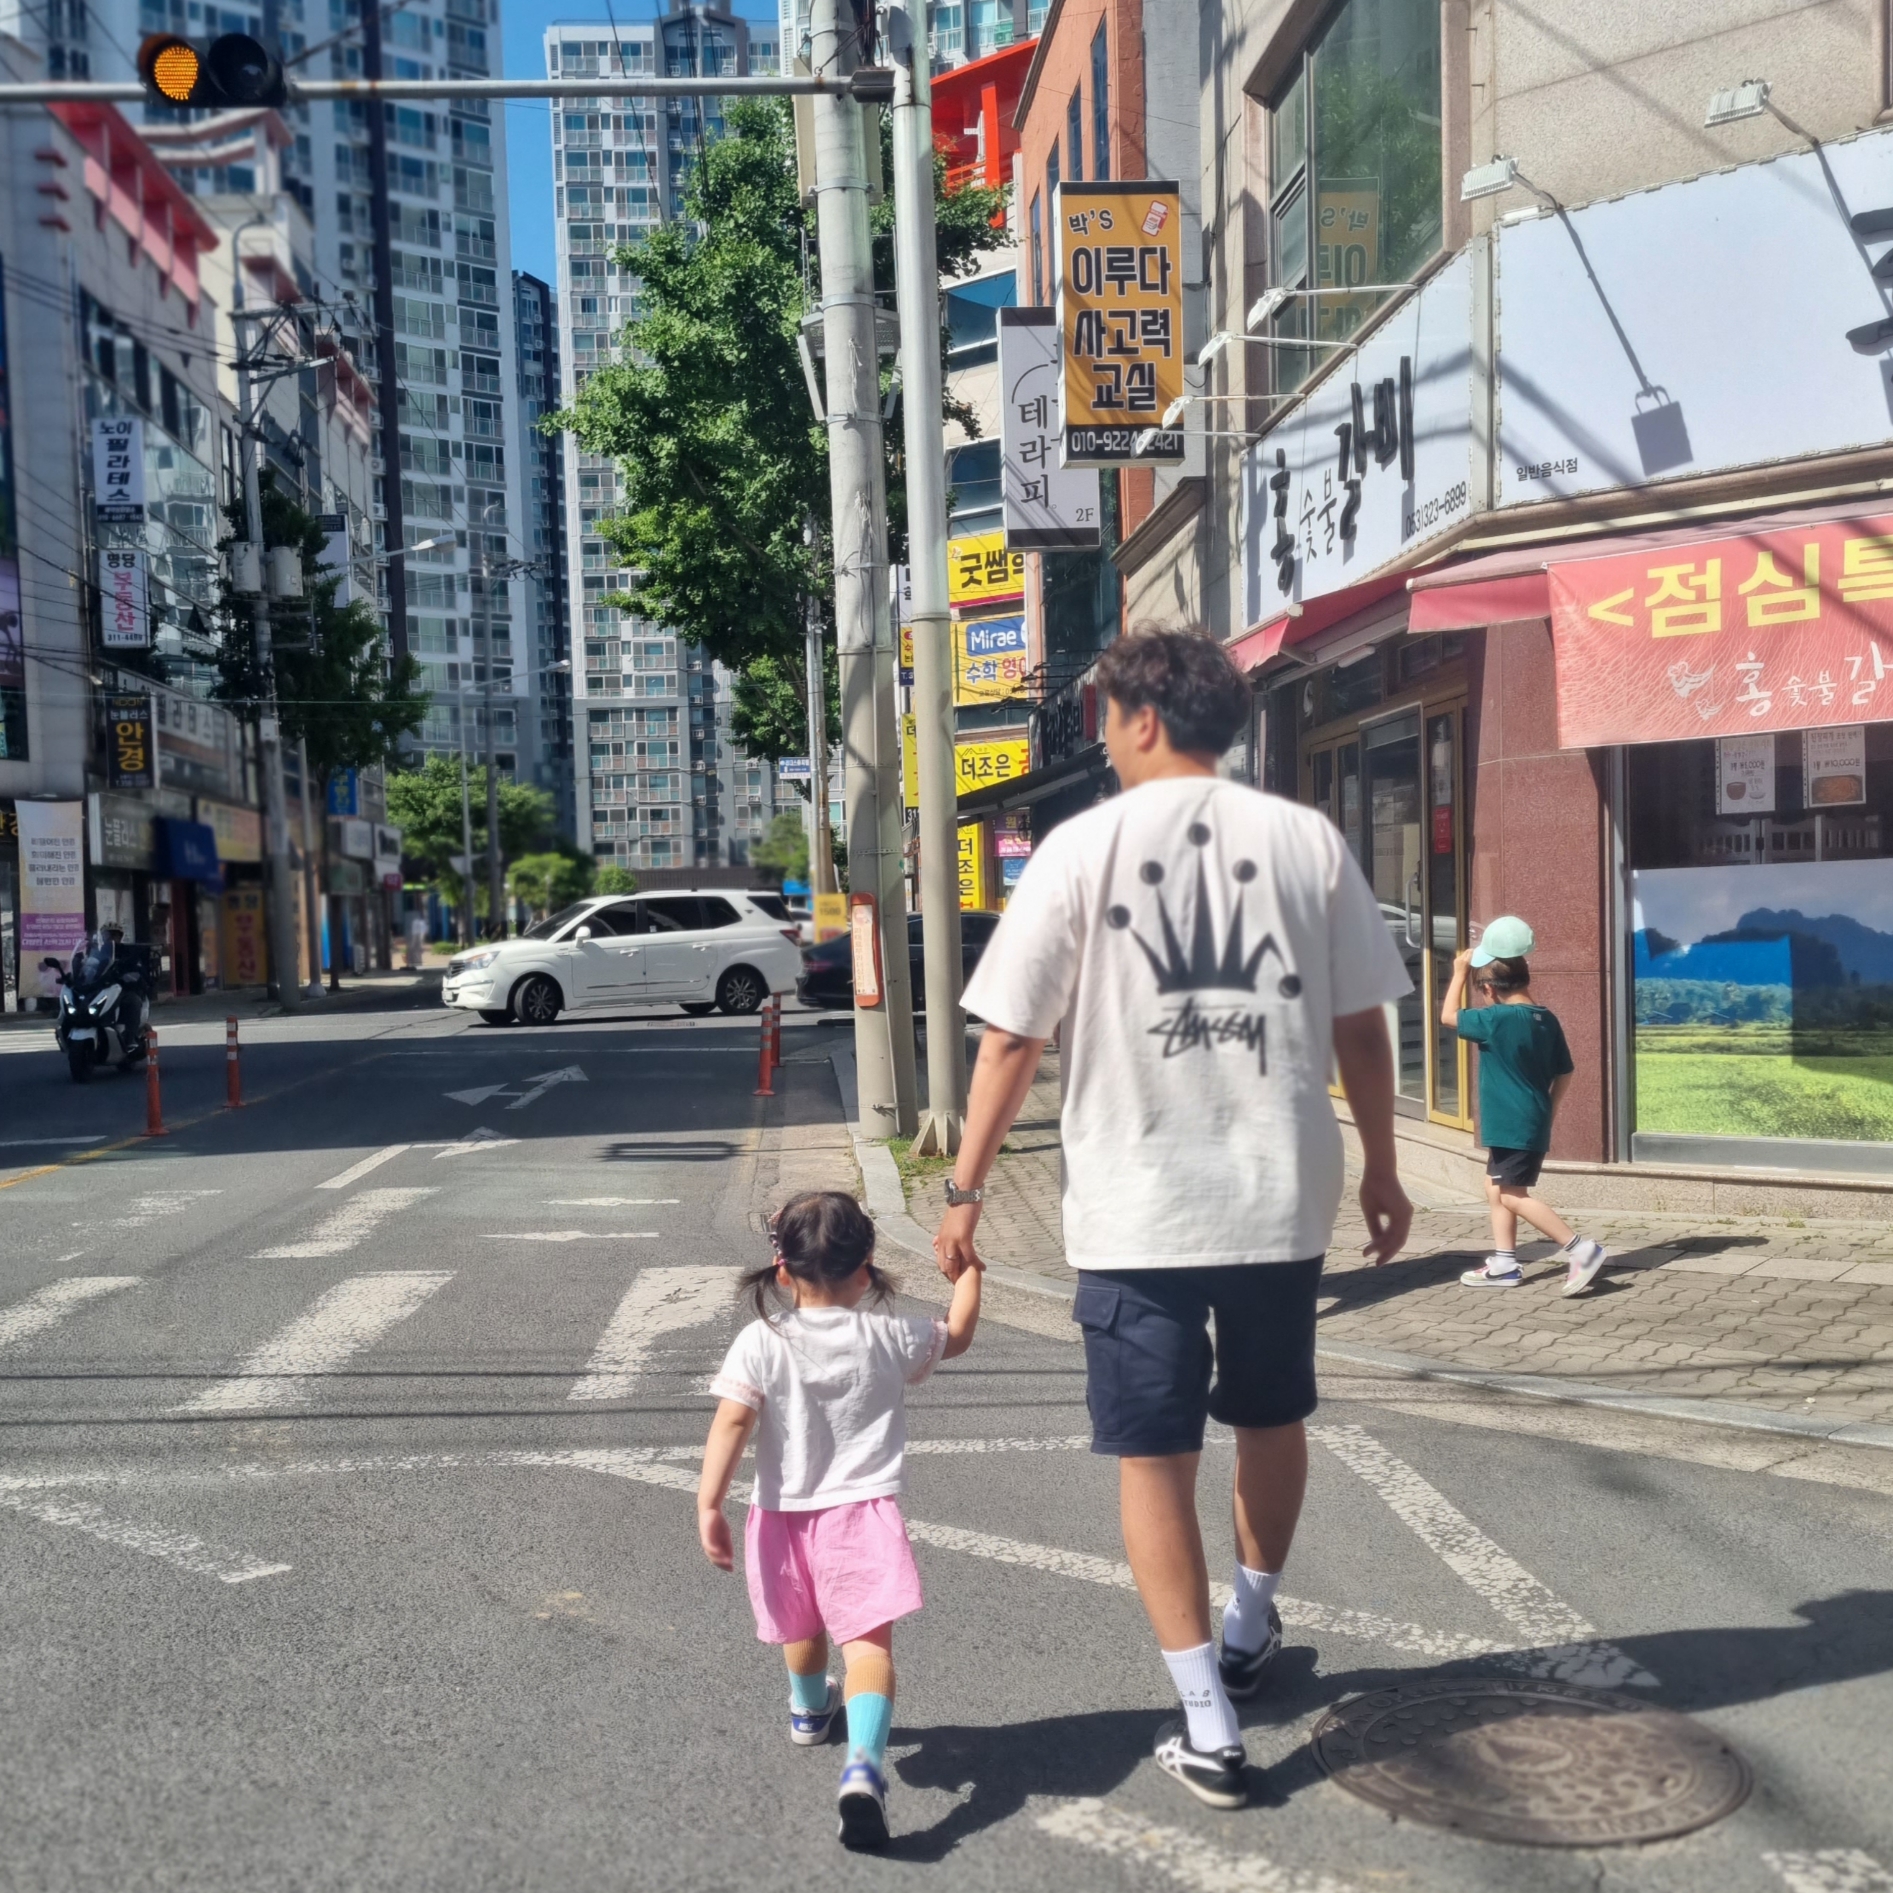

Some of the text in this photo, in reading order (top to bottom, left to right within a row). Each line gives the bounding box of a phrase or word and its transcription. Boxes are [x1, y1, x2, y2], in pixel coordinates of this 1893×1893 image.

[1070, 245, 1172, 297] 이루다
[1073, 307, 1172, 359] 사고력
[1091, 362, 1157, 413] 교실
[99, 421, 133, 435] 노이
[107, 438, 131, 502] 필라테스
[1516, 457, 1579, 482] 일반음식점
[1075, 507, 1095, 523] 2F
[1405, 480, 1468, 538] 053)323-6899
[106, 552, 136, 569] 명당
[113, 571, 136, 631] 부동산
[971, 630, 1017, 651] Mirae
[966, 660, 998, 683] 수학
[116, 722, 145, 771] 안경
[961, 752, 1012, 781] 더조은
[957, 837, 976, 897] 더조은
